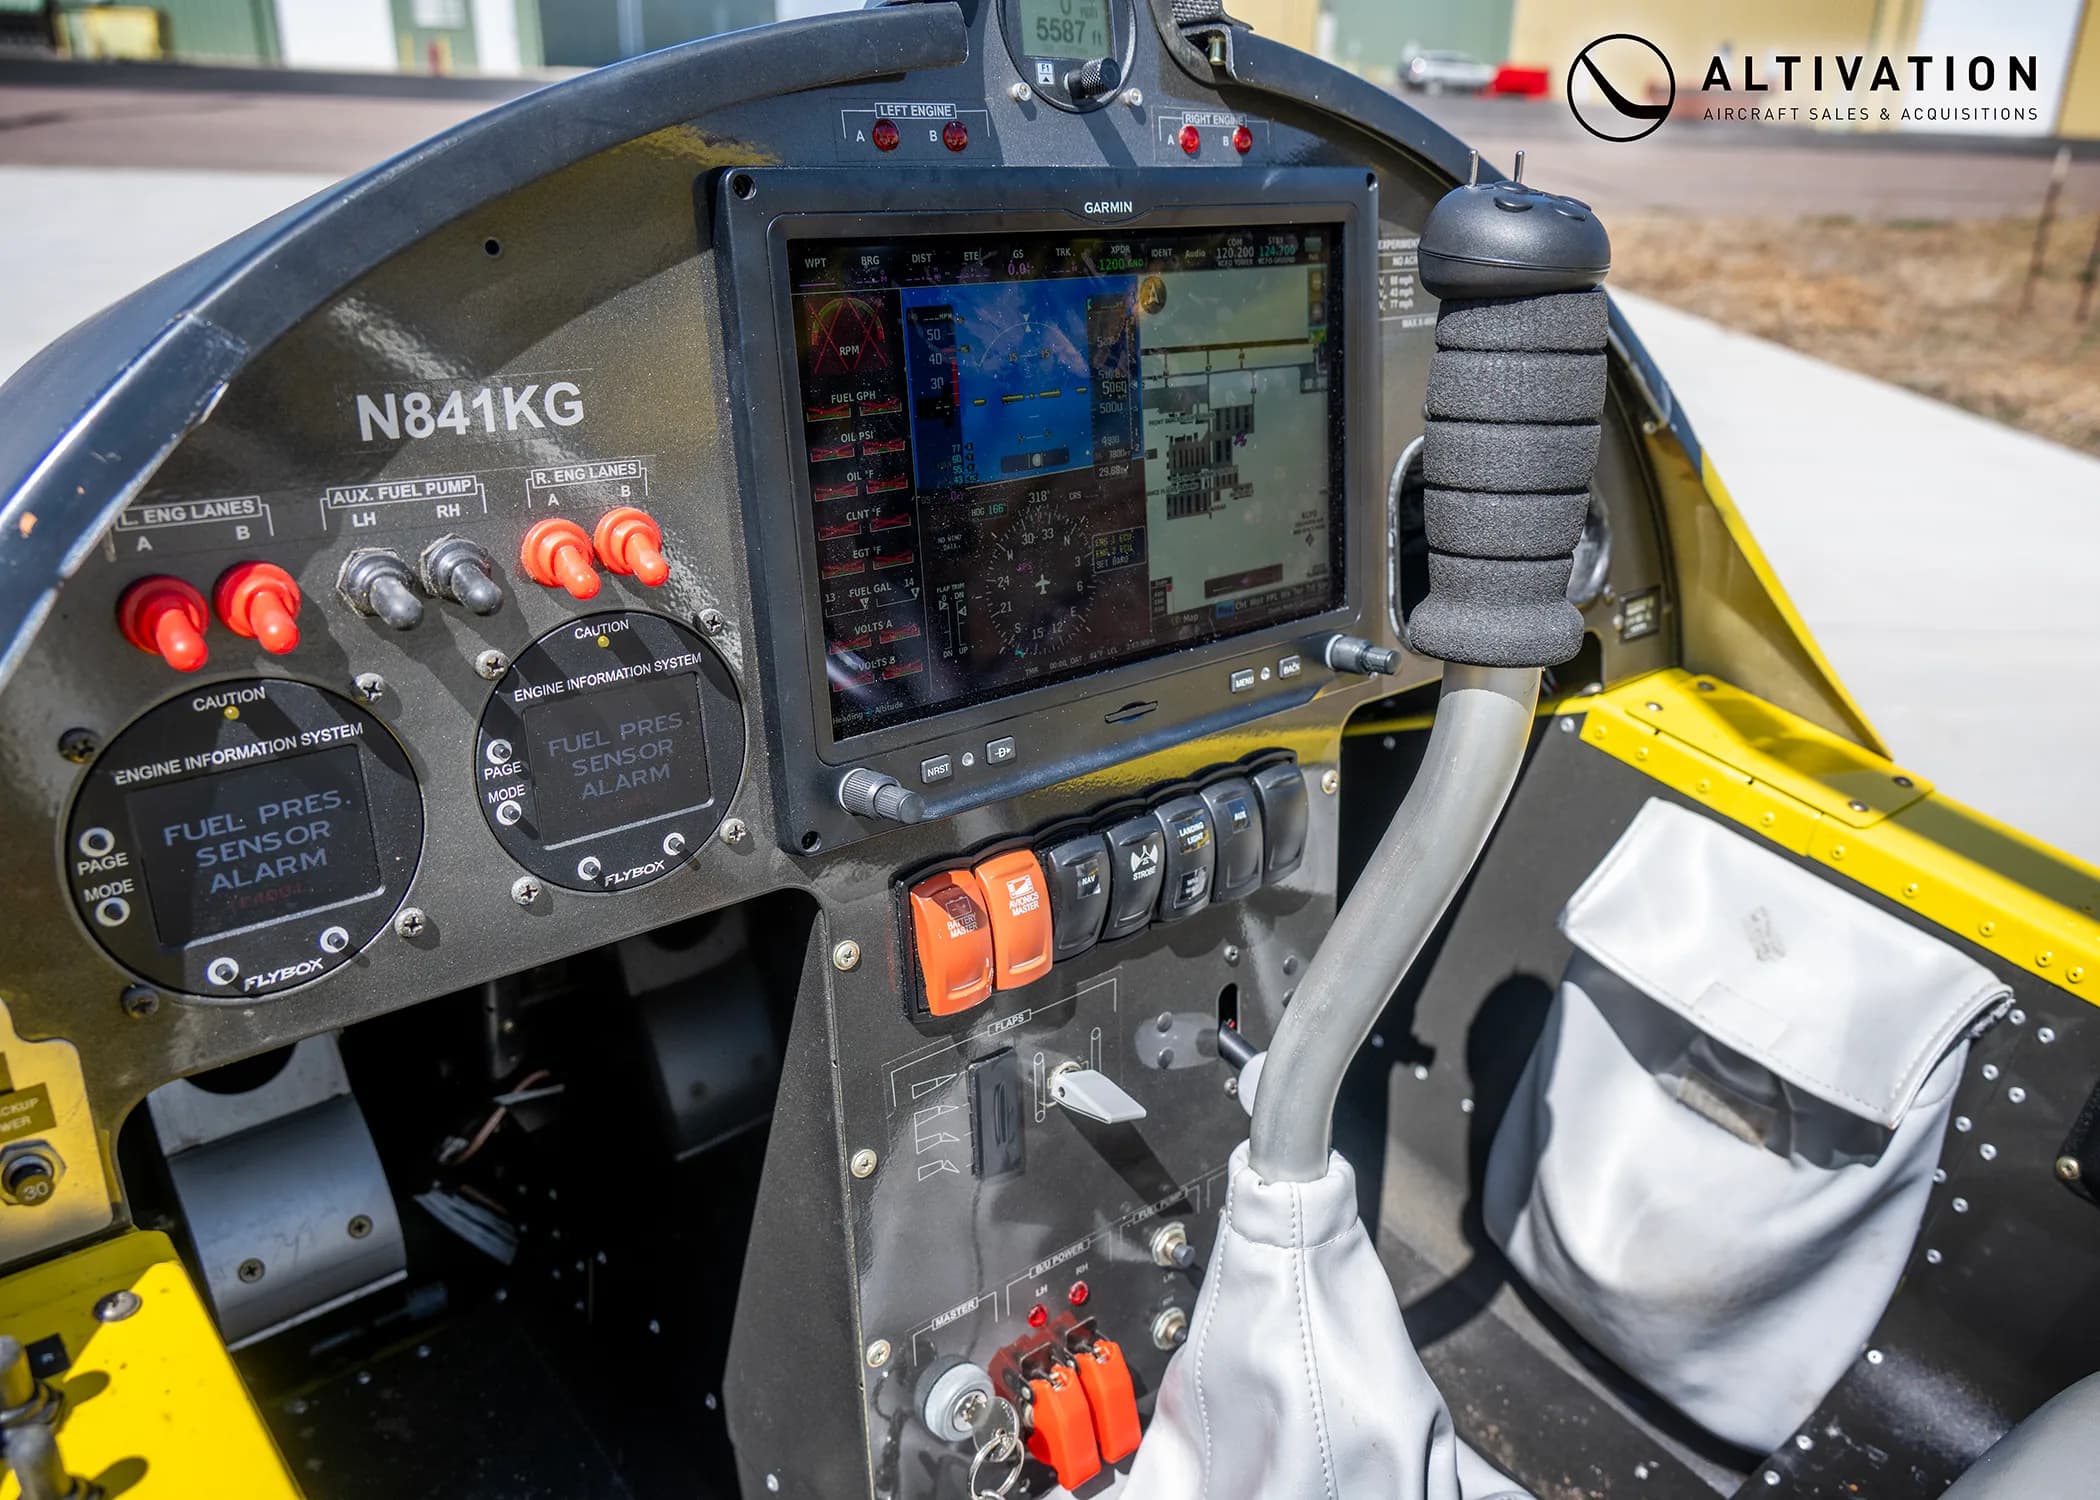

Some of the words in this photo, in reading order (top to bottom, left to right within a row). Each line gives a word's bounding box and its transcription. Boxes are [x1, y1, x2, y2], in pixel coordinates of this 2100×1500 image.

[1037, 16, 1086, 43] 5587
[1093, 30, 1102, 45] ft
[1041, 64, 1050, 72] F1
[880, 105, 908, 116] LEFT
[911, 105, 952, 117] ENGINE
[1185, 114, 1211, 125] RIGHT
[1213, 114, 1244, 126] ENGINE
[856, 130, 866, 142] A
[929, 130, 938, 142] B
[1168, 134, 1175, 145] A
[1222, 136, 1230, 146] B
[1084, 201, 1133, 214] GARMIN
[964, 251, 979, 262] ETE
[1013, 249, 1024, 259] GS
[1056, 248, 1072, 257] TRK
[1110, 245, 1131, 255] XPDR
[1151, 248, 1173, 257] IDENT
[1185, 248, 1206, 259] Audio
[1216, 246, 1254, 259] 120.200
[804, 258, 827, 269] WPT
[860, 255, 881, 266] BRG
[911, 253, 932, 264] DIST
[1099, 258, 1125, 272] 1200
[926, 328, 941, 341] 50
[839, 345, 860, 356] RPM
[928, 352, 943, 365] 40
[930, 376, 944, 390] 30
[831, 393, 855, 404] FUEL
[856, 390, 876, 401] GPH
[356, 382, 584, 442] N841KG
[840, 432, 857, 443] OIL
[859, 430, 874, 440] PSI
[536, 471, 552, 485] R.
[556, 467, 595, 484] ENG
[599, 462, 637, 479] LANES
[846, 471, 862, 483] OIL
[866, 470, 874, 479] °F
[332, 488, 375, 506] AUX.
[378, 484, 422, 502] FUEL
[426, 478, 472, 497] PUMP
[548, 493, 560, 507] A
[621, 484, 632, 498] B
[144, 506, 185, 525] ENG
[188, 501, 255, 521] LANES
[352, 512, 376, 528] LH
[436, 503, 462, 519] RH
[846, 508, 870, 521] CLNT
[136, 536, 153, 553] A
[236, 525, 251, 541] B
[1041, 528, 1054, 540] 33
[852, 548, 871, 560] EGT
[1074, 556, 1081, 568] 3
[997, 576, 1010, 588] 24
[1077, 581, 1083, 592] 6
[825, 593, 836, 604] 13
[848, 588, 872, 598] FUEL
[874, 582, 892, 593] GAL
[1000, 601, 1012, 614] 21
[1070, 606, 1077, 617] E
[574, 620, 629, 640] CAUTION
[854, 622, 884, 635] VOLTS
[886, 620, 894, 628] A
[1014, 622, 1021, 634] S
[1032, 627, 1044, 640] 15
[859, 658, 887, 672] VOLTS
[514, 681, 564, 702] ENGINE
[567, 663, 651, 691] INFORMATION
[654, 652, 701, 673] SYSTEM
[193, 687, 266, 712] CAUTION
[549, 730, 611, 757] FUEL
[115, 759, 182, 785] ENGINE
[185, 736, 297, 770] INFORMATION
[300, 722, 364, 748] SYSTEM
[572, 738, 674, 778] SENSOR
[484, 761, 522, 781] PAGE
[928, 763, 950, 777] NRST
[582, 763, 671, 800] ALARM
[488, 784, 526, 804] MODE
[162, 812, 246, 847] FUEL
[258, 790, 351, 825] PRES.
[1179, 822, 1205, 837] LANDING
[196, 820, 331, 868] SENSOR
[1187, 832, 1205, 845] LIGHT
[77, 852, 129, 876] PAGE
[210, 848, 328, 894] ALARM
[604, 860, 666, 887] FLYBOX
[1082, 875, 1096, 886] NAV
[1133, 866, 1157, 881] STROBE
[84, 878, 135, 902] MODE
[1009, 891, 1040, 909] AVIONICS
[1011, 900, 1040, 917] MASTER
[946, 912, 977, 930] BATTERY
[950, 922, 978, 939] MASTER
[244, 958, 324, 991] FLYBOX
[995, 1013, 1025, 1032] FLAPS
[24, 1182, 49, 1202] 30
[1052, 1242, 1085, 1266] POWER
[1076, 1263, 1089, 1276] RH
[1036, 1284, 1049, 1298] LH
[935, 1301, 975, 1328] MASTER
